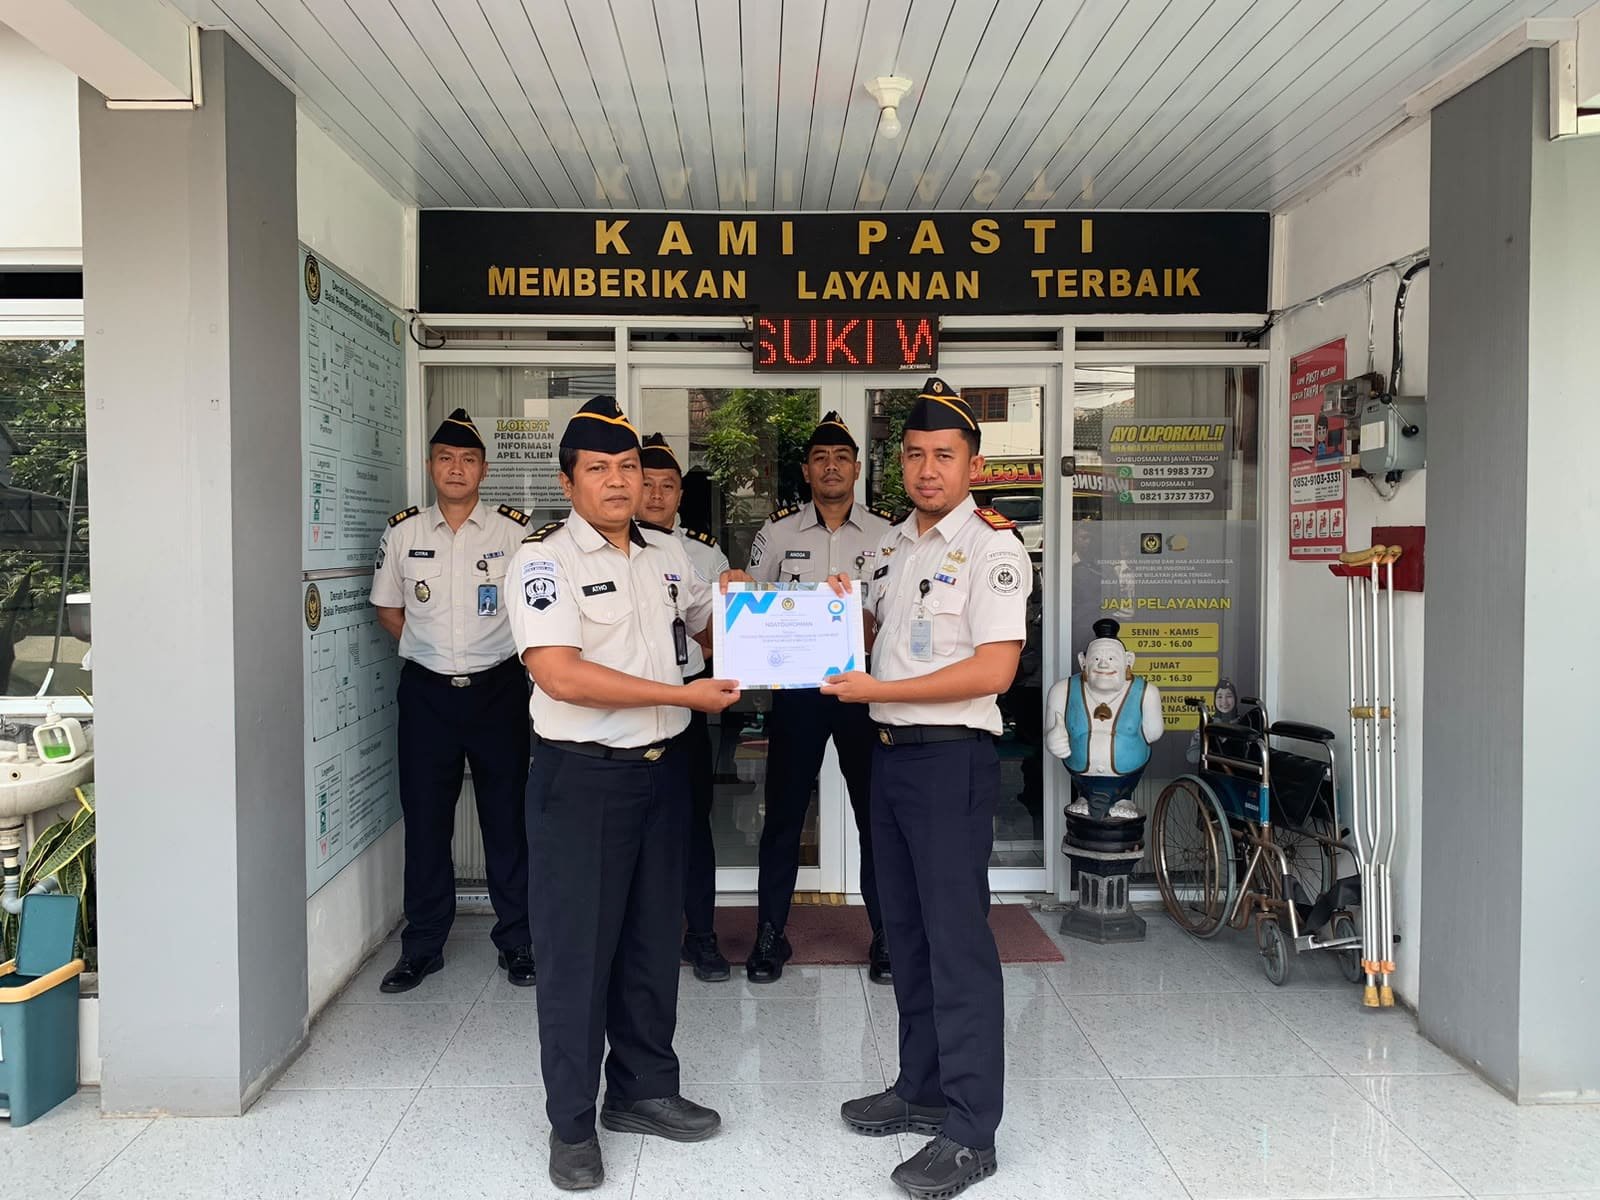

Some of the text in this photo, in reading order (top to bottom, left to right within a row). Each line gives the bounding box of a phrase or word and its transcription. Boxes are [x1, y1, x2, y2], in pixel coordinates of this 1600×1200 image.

[595, 218, 1093, 256] KAMI PASTI
[487, 267, 1201, 300] MEMBERIKAN LAYANAN TERBAIK
[496, 419, 550, 432] LOKET
[494, 432, 554, 440] PENGADUAN
[1109, 425, 1138, 442] AYO
[497, 441, 552, 450] INFORMASI
[496, 451, 553, 459] APEL KLIEN
[1142, 467, 1209, 476] 0811 9983 737
[1139, 492, 1211, 501] 0821 3737 3737
[592, 583, 608, 593] ATHO
[1101, 598, 1231, 609] JAM PELAYANAN
[1131, 628, 1160, 636] SENIN
[1169, 628, 1199, 636] KAMIS
[1137, 640, 1162, 648] 07.30
[1170, 640, 1193, 648] 16.00
[1149, 661, 1181, 671] JUMAT
[1170, 674, 1193, 682] 16.30
